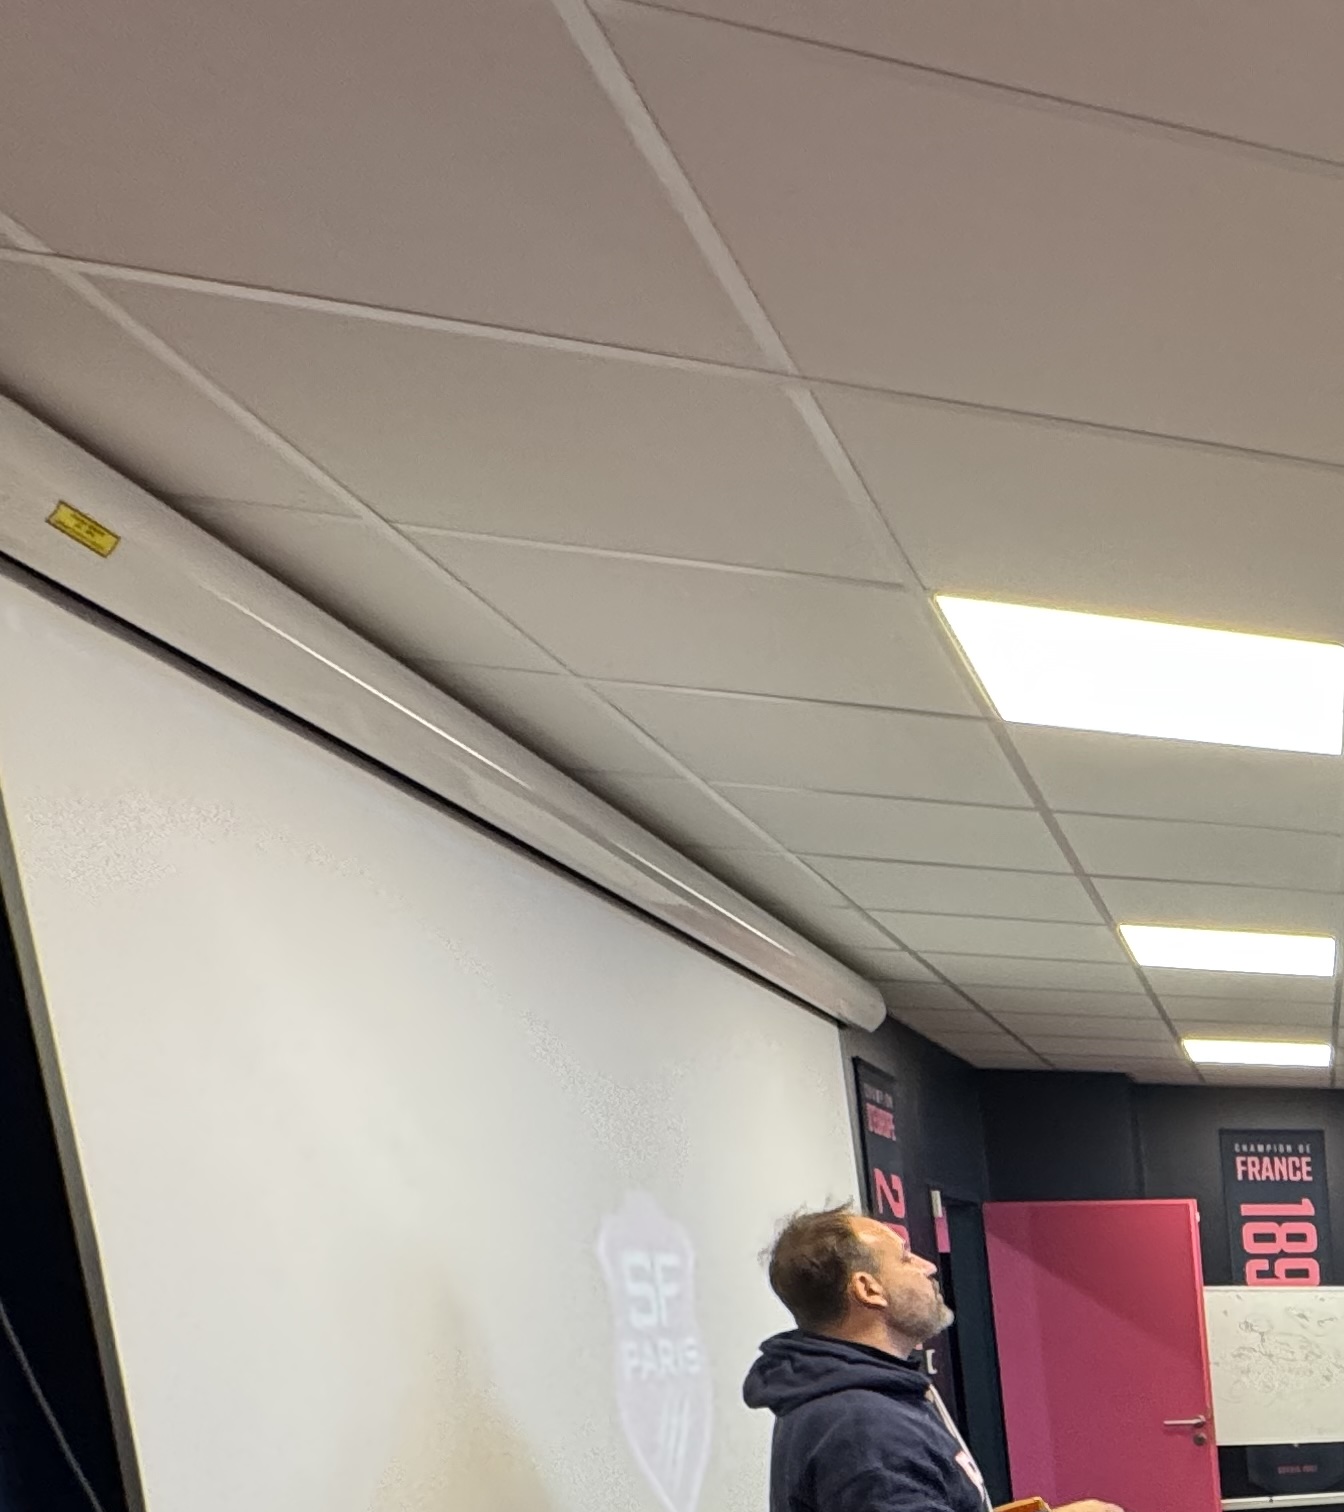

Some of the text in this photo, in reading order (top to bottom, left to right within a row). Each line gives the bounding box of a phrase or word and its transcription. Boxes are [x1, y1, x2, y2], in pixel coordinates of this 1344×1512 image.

[1235, 1156, 1313, 1182] FRANCE
[1240, 1198, 1321, 1287] 189
[622, 1250, 682, 1329] SF
[622, 1336, 702, 1381] PARIS
